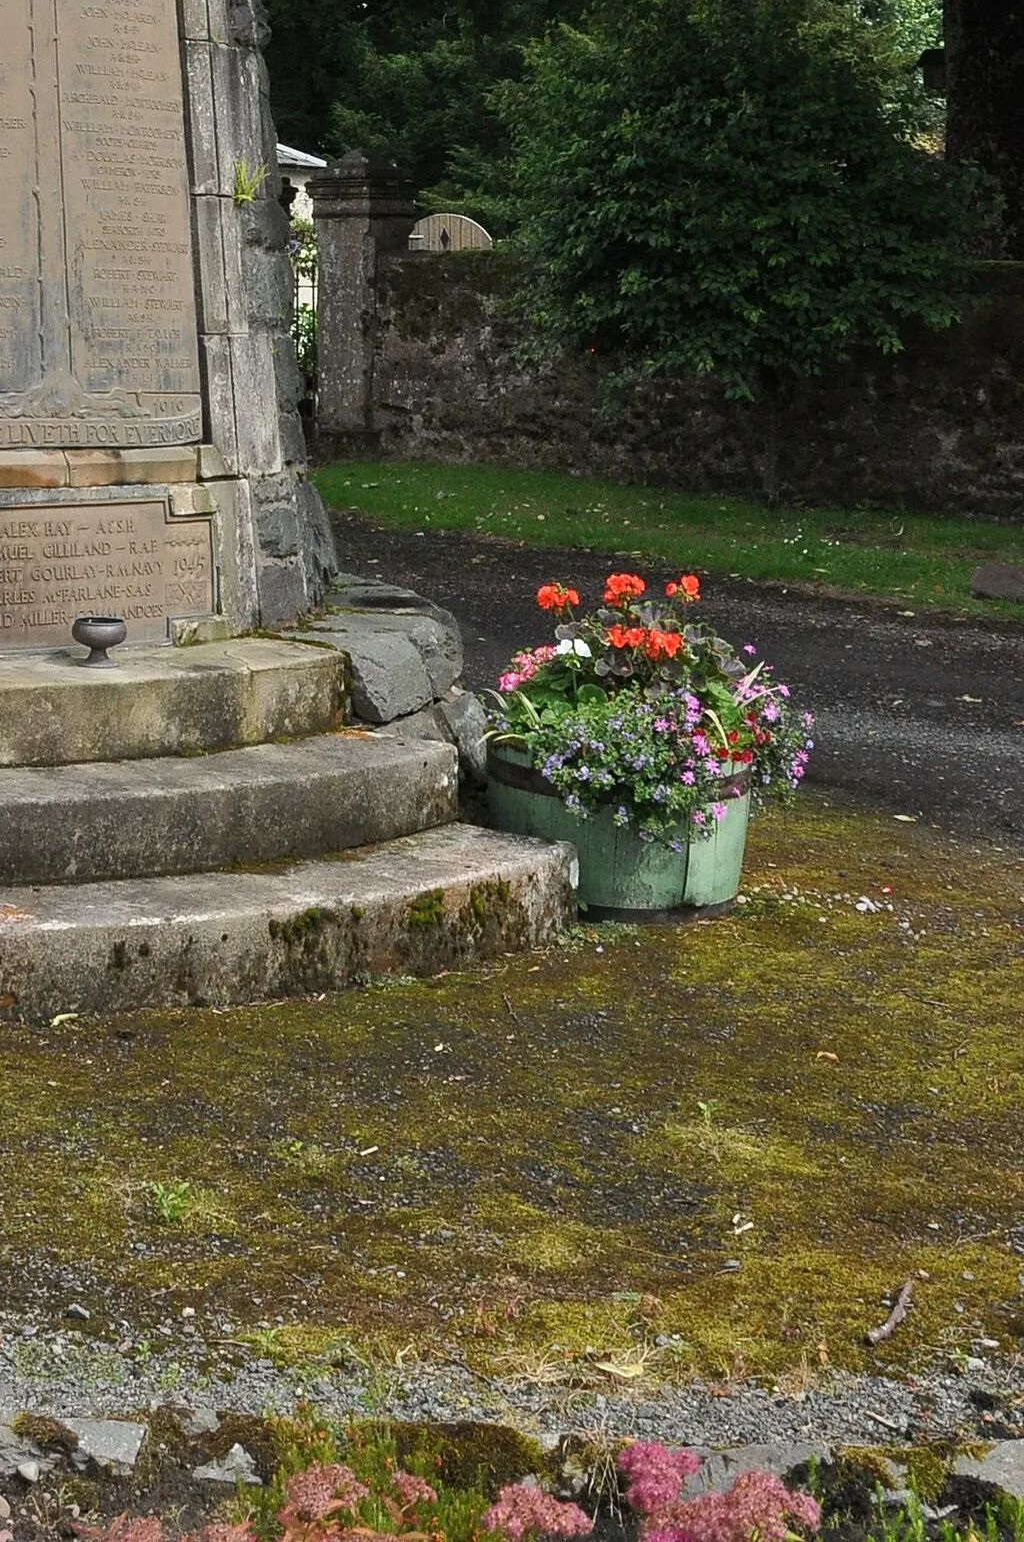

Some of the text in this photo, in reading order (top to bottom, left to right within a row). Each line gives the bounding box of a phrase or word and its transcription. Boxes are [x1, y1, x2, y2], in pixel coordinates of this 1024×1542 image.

[8, 423, 80, 445] LIVETH
[85, 423, 120, 444] FOR
[124, 417, 200, 444] EVERMORE
[0, 521, 40, 538] ALEX
[44, 521, 71, 537] HAY
[43, 541, 111, 558] GILLILAND
